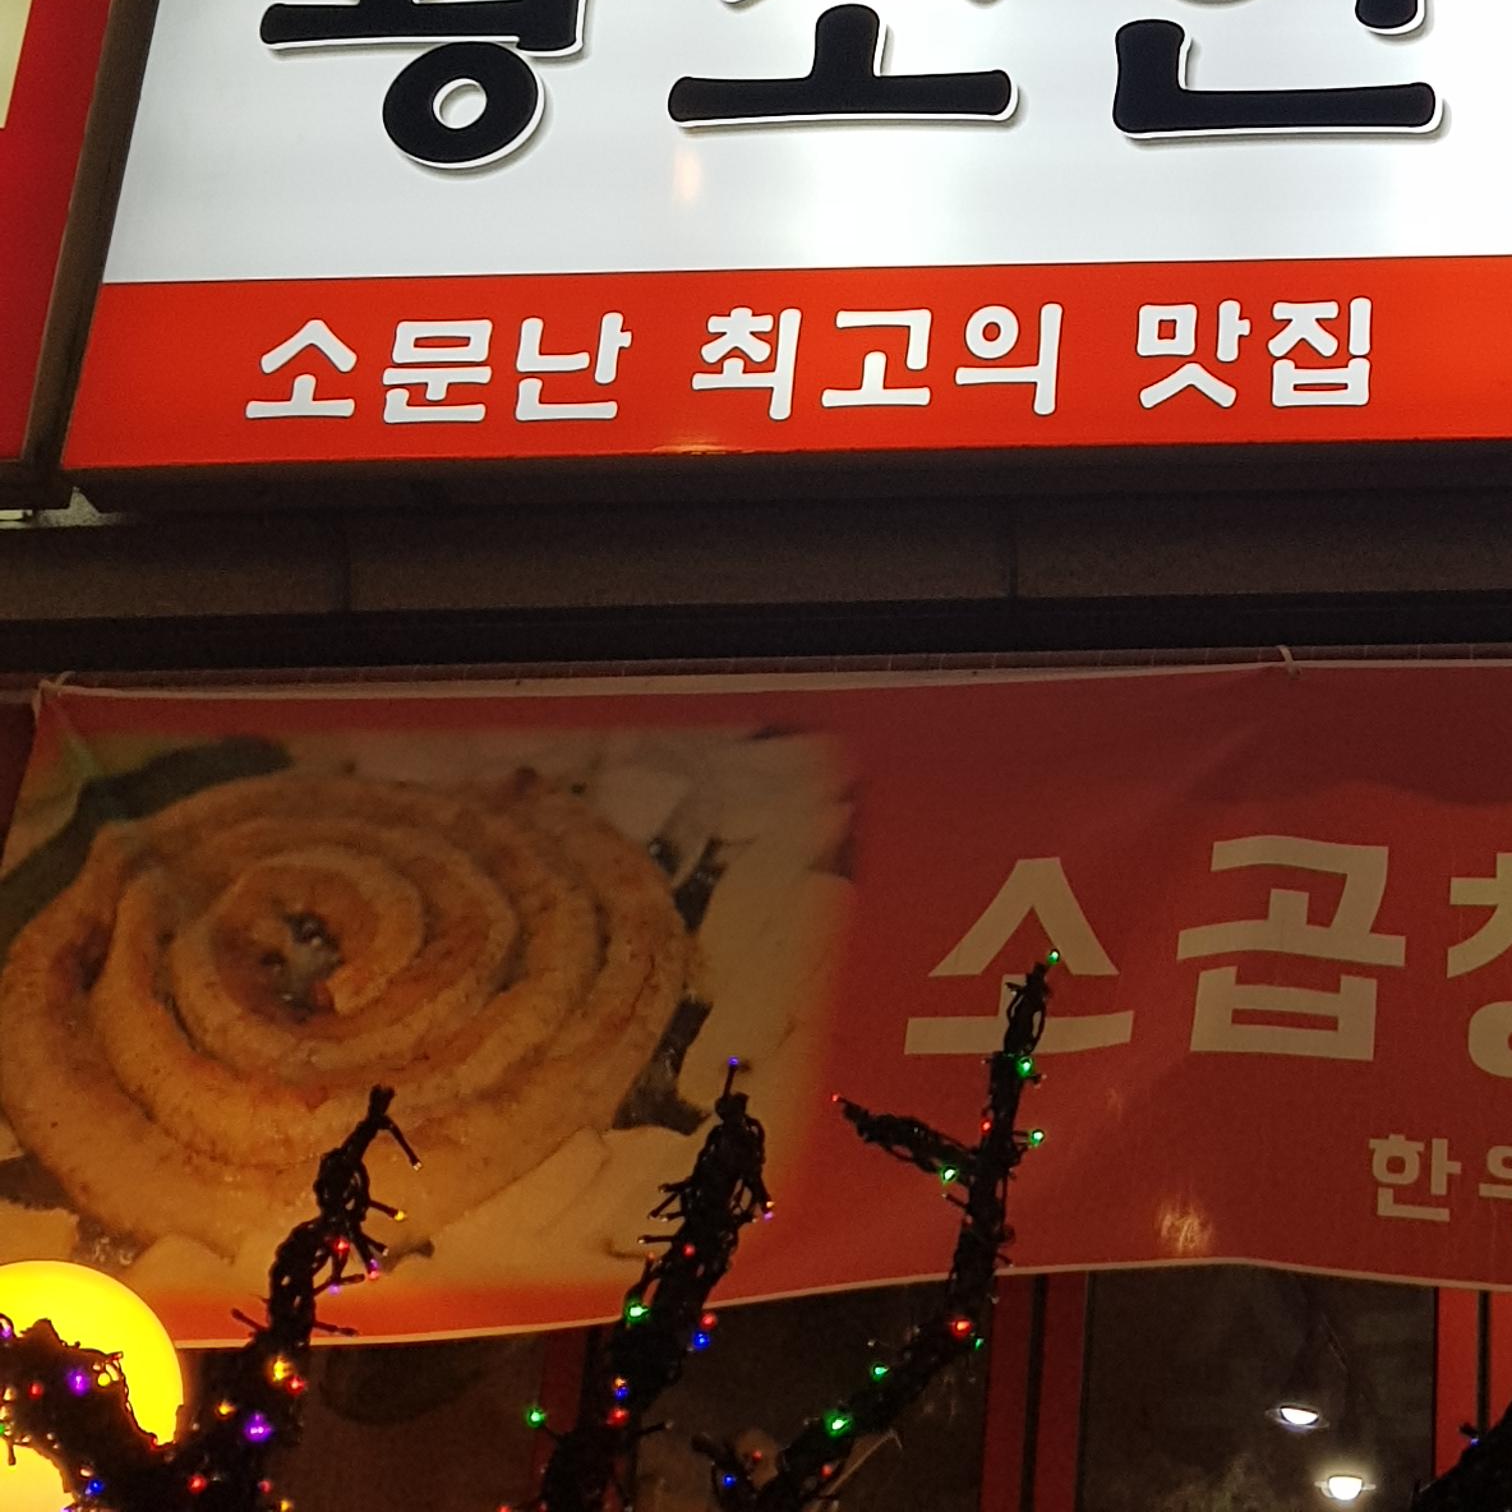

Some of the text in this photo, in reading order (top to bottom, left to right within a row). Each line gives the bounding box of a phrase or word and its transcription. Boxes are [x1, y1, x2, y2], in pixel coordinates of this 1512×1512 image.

[244, 296, 1375, 424] 소문난 최고의 맛집
